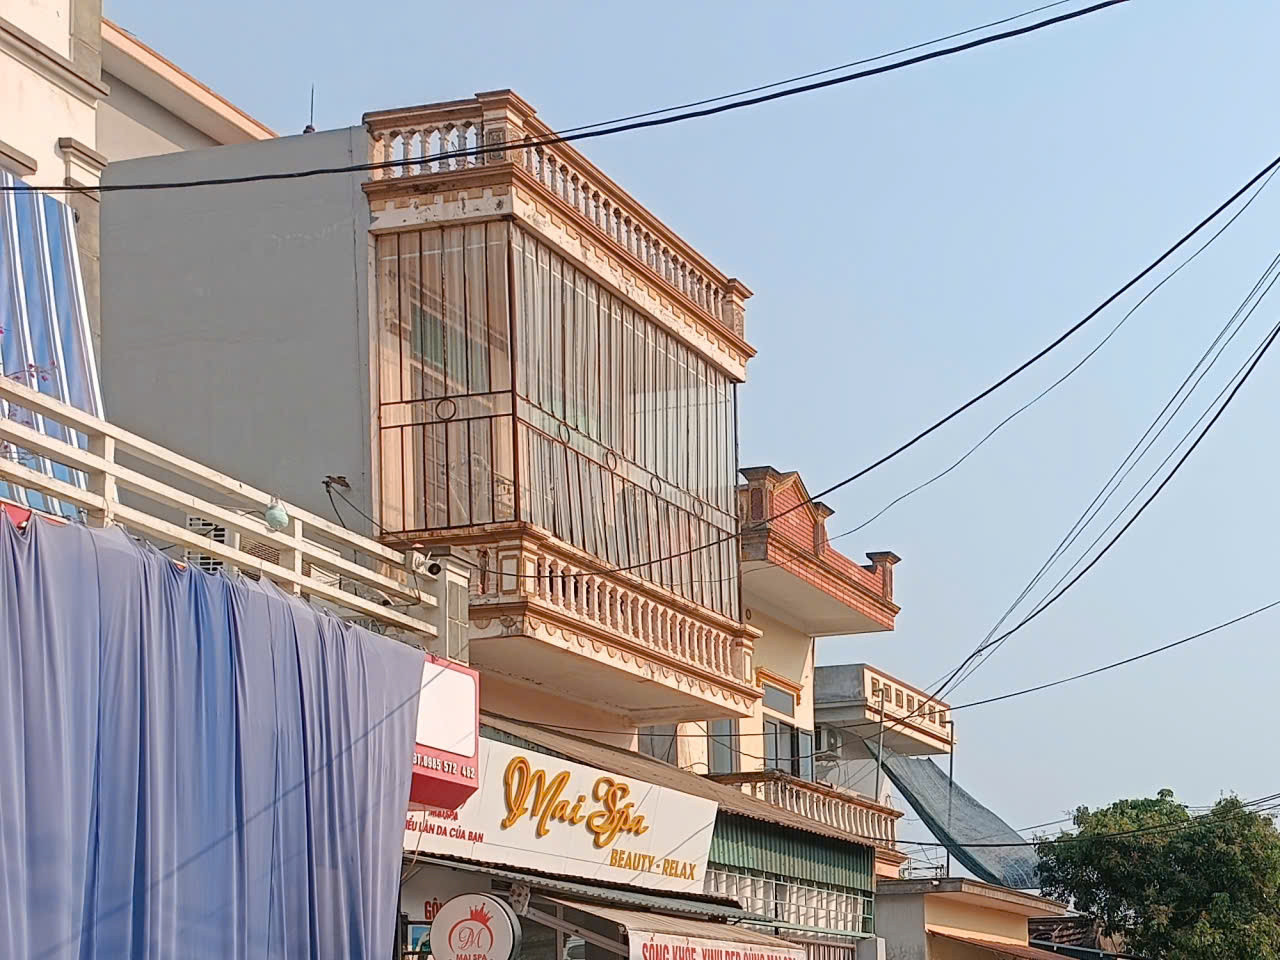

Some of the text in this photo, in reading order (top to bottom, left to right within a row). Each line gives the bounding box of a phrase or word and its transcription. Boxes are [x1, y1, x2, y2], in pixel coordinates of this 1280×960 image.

[444, 761, 457, 774] 572
[500, 756, 649, 849] Mai Spa
[405, 815, 417, 831] IỂU
[436, 826, 448, 837] DA
[449, 825, 466, 840] CỦA
[468, 831, 484, 844] BẠN
[609, 848, 656, 872] BEAUTY
[661, 858, 697, 881] RELAX
